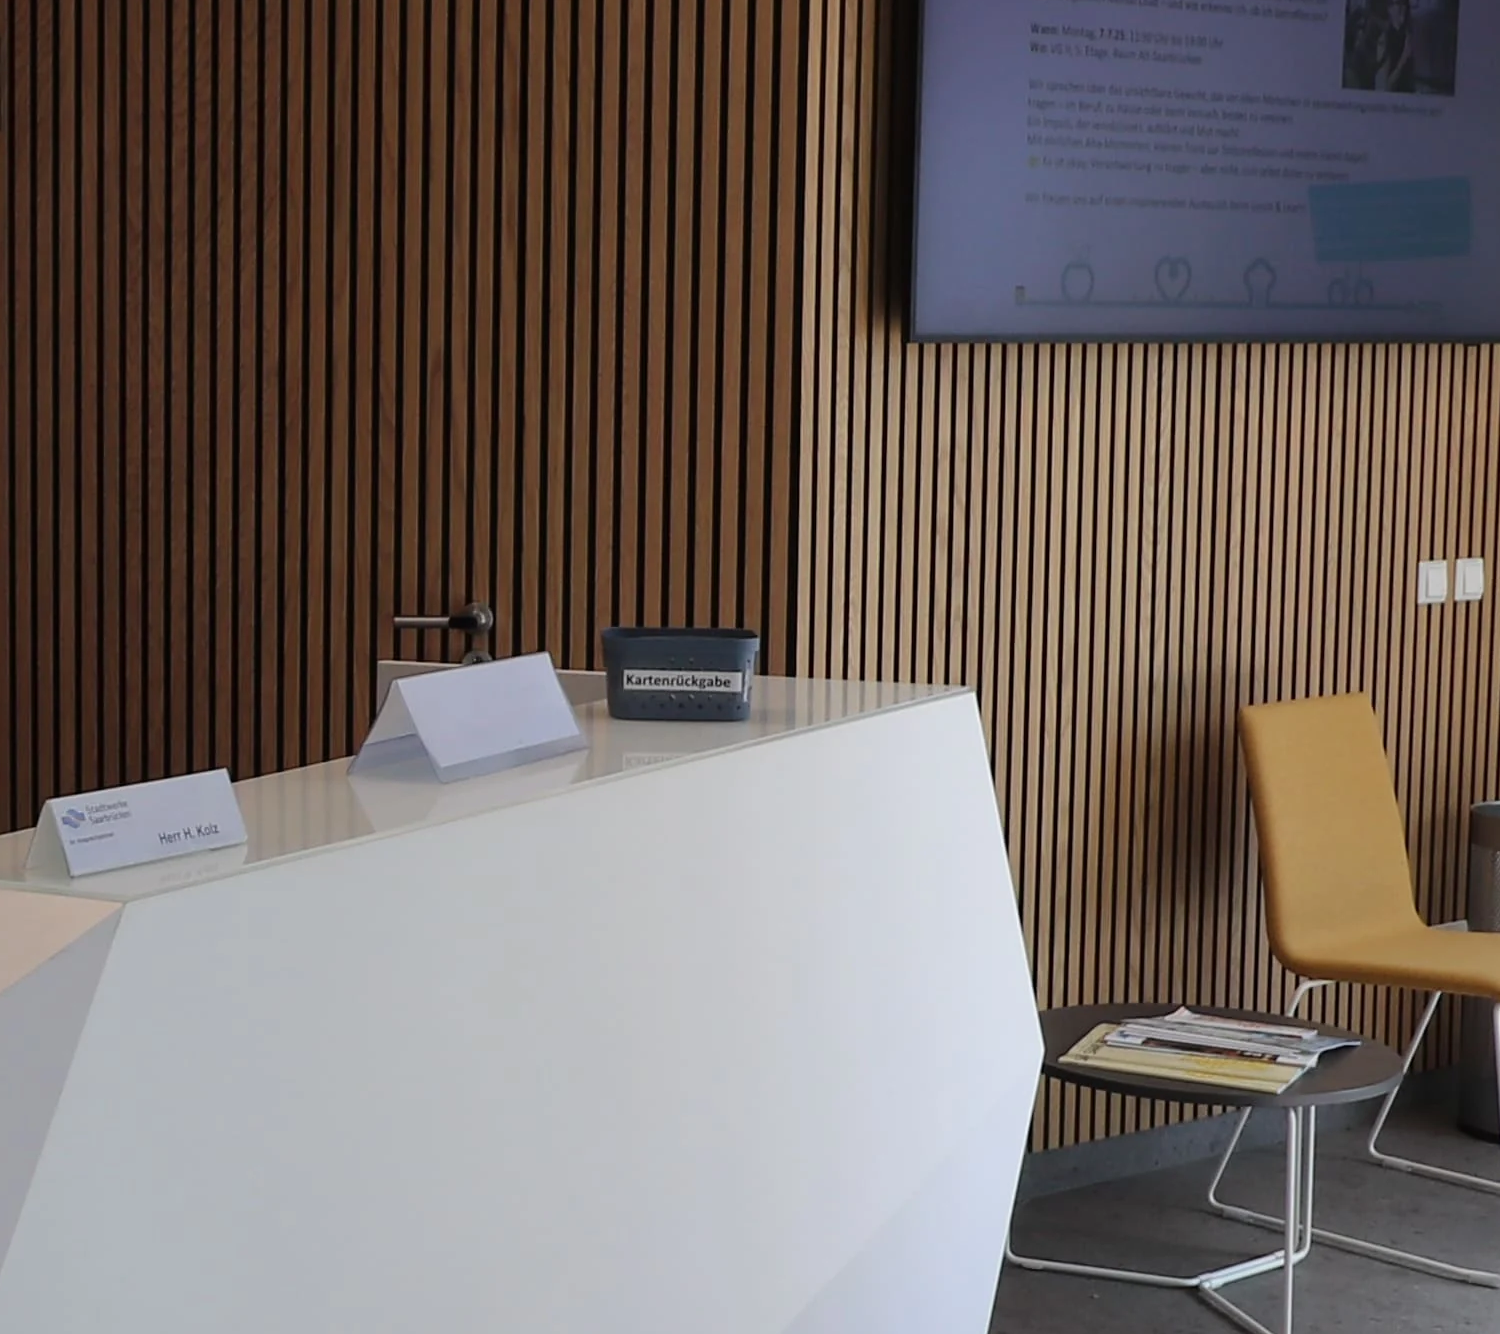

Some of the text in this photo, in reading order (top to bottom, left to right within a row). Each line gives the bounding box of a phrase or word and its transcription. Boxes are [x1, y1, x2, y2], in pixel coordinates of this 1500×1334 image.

[626, 674, 732, 689] Kartenrückgabe
[85, 800, 128, 813] Stadtwerke
[87, 810, 132, 825] Saarbrücken
[158, 822, 220, 845] Herr H. Kolz
